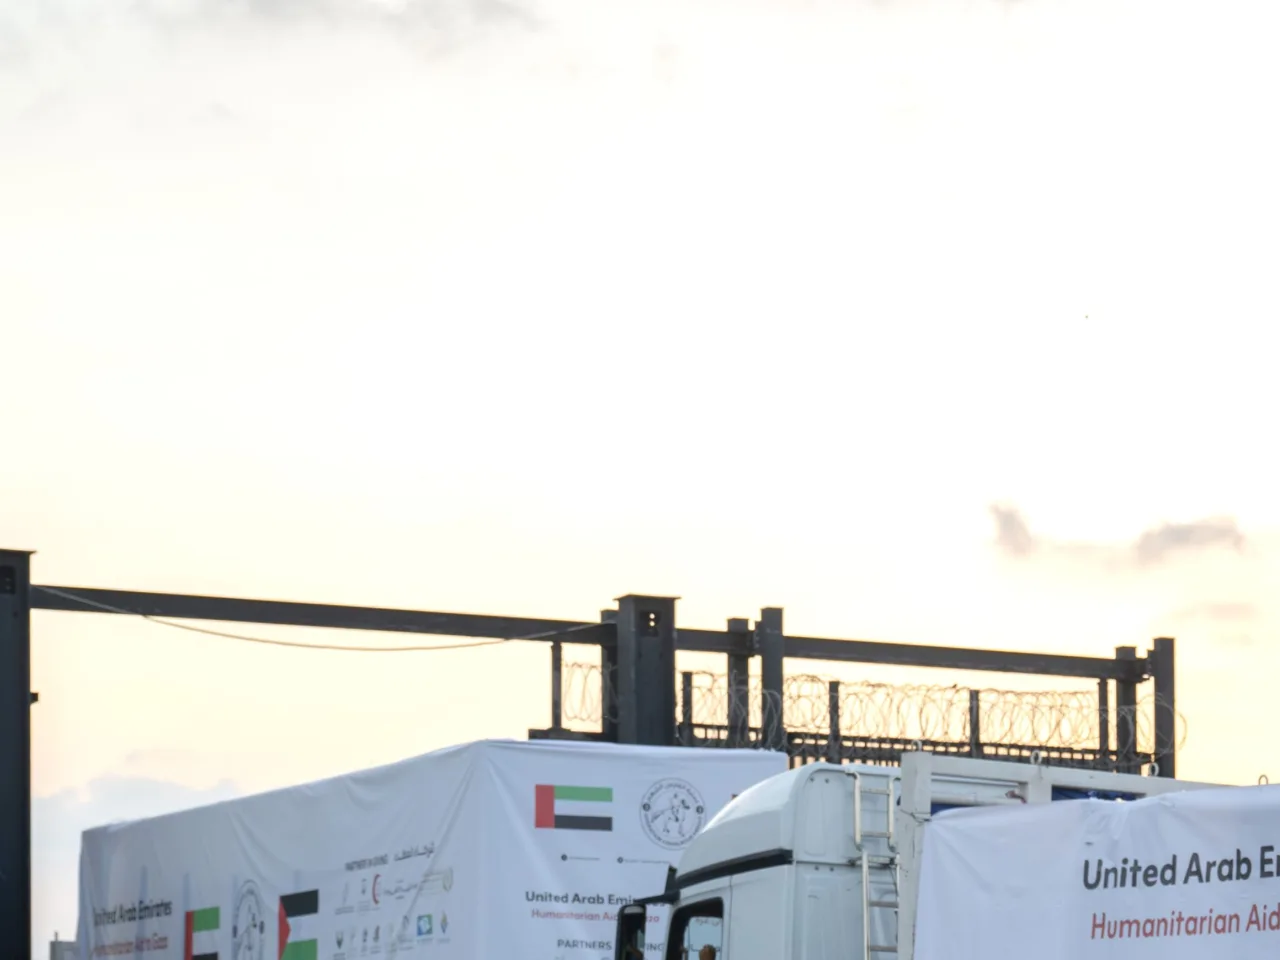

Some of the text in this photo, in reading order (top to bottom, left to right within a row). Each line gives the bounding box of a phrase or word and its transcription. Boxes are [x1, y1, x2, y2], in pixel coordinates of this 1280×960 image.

[1083, 854, 1177, 890] United
[1183, 848, 1252, 884] Arab
[526, 891, 569, 904] United
[572, 893, 605, 905] Arab
[1091, 908, 1240, 940] Humanitarian
[557, 939, 612, 951] PARTNERS
